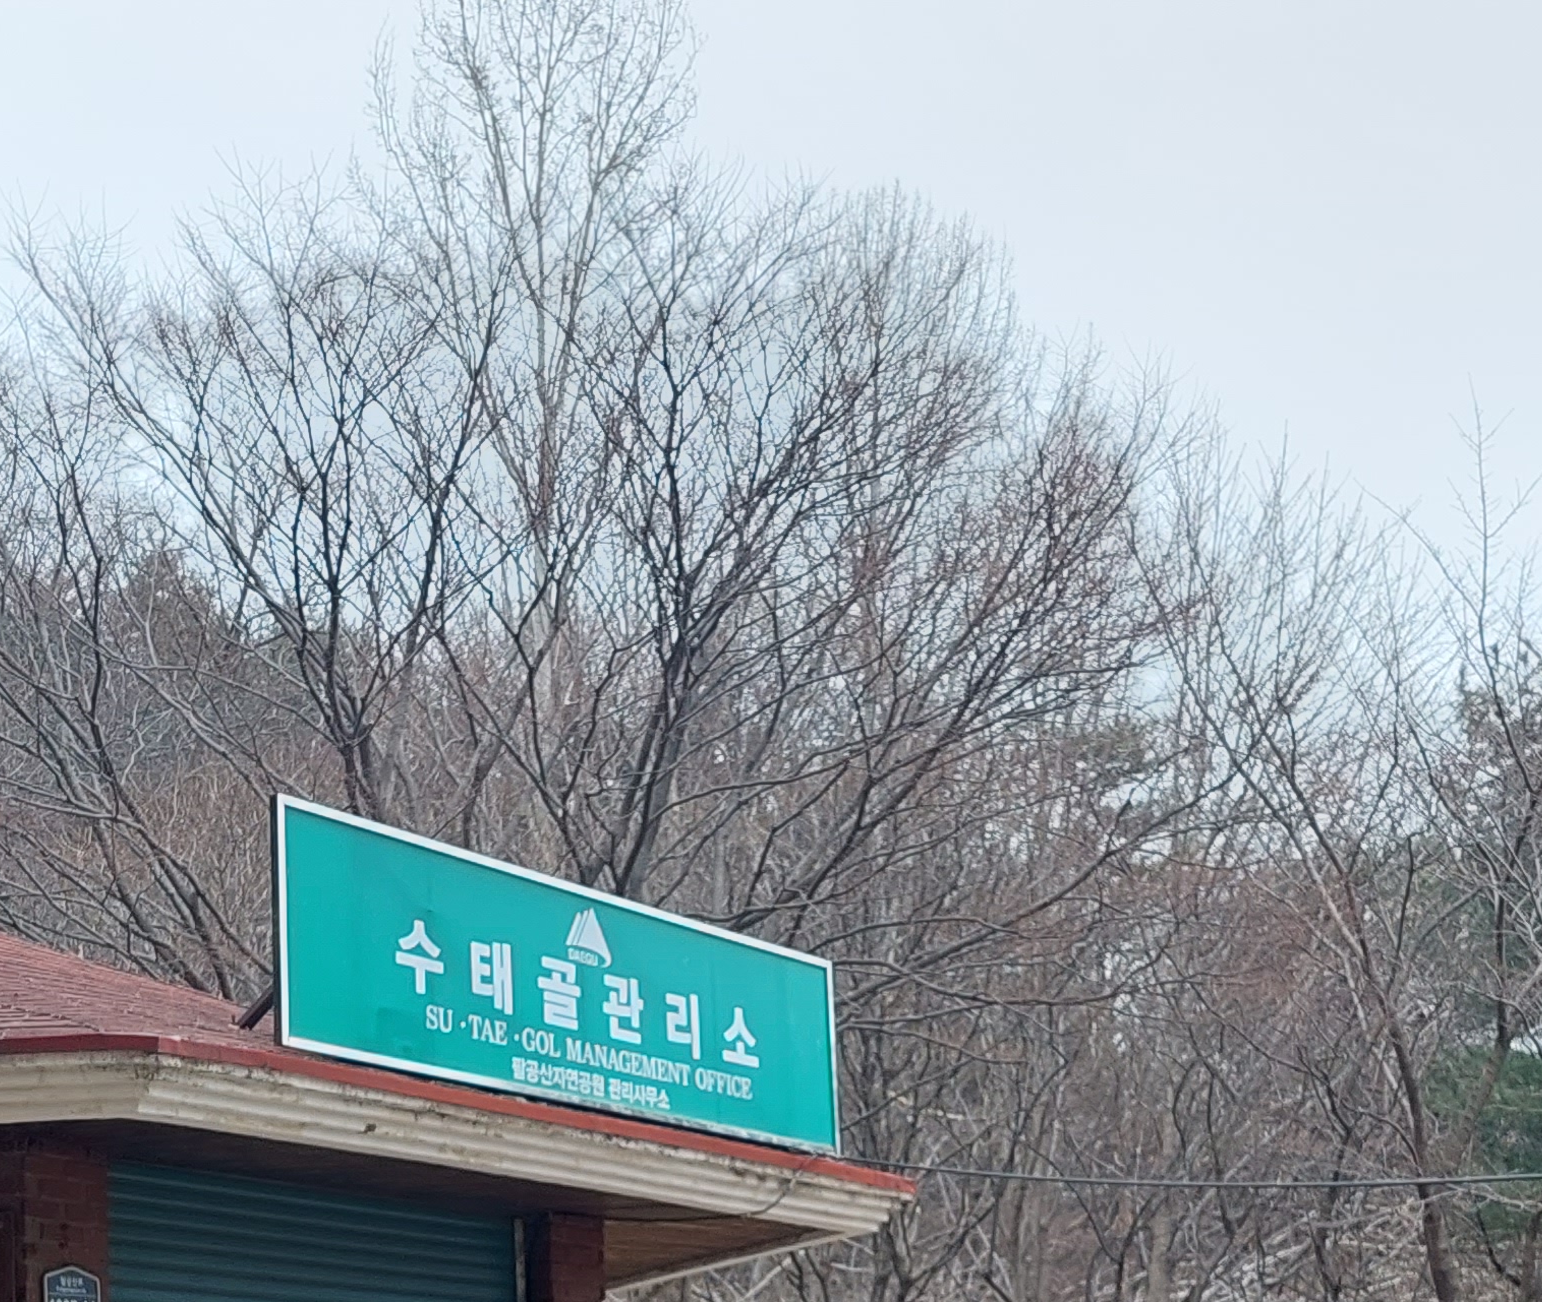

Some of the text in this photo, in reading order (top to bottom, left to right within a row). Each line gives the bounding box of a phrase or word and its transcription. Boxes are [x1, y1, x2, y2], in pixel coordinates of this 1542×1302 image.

[567, 947, 599, 967] DAEGU
[511, 1056, 671, 1110] 팔공산자연공원 관리사무소
[566, 1037, 691, 1086] MANAGEMENT
[694, 1066, 753, 1100] OFFICE
